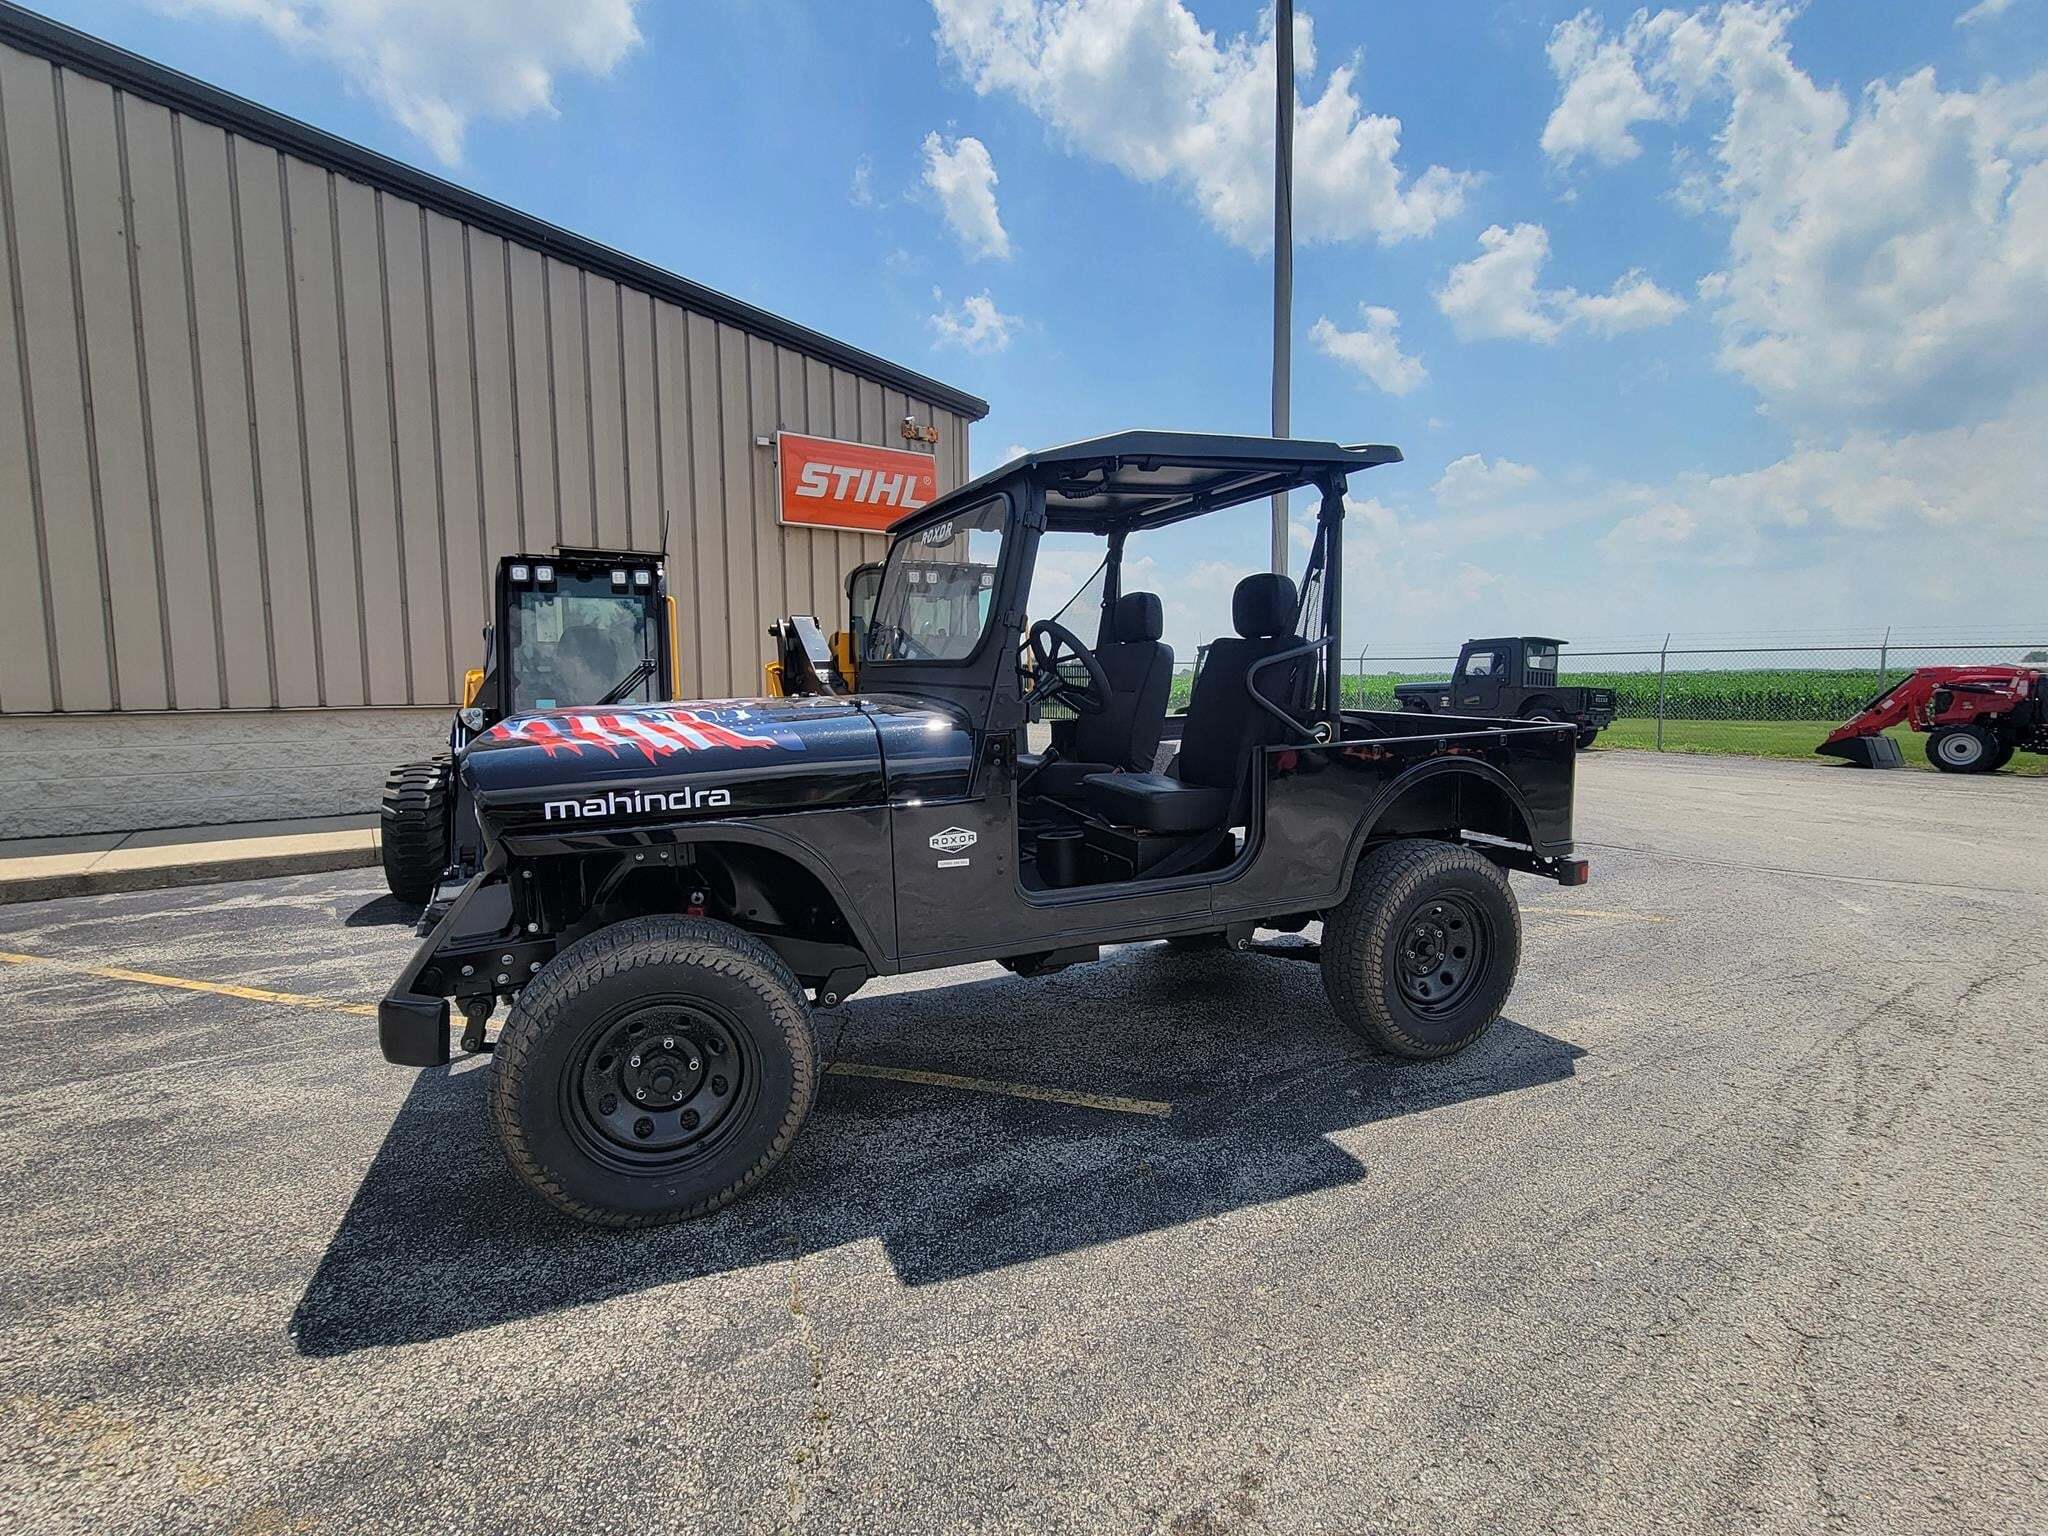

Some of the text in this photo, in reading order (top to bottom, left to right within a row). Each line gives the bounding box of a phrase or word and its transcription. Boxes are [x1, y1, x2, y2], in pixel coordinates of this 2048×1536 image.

[795, 461, 928, 509] STIHL
[921, 521, 953, 546] ROXOR
[545, 787, 731, 820] mahindra
[932, 835, 974, 845] ROXOR
